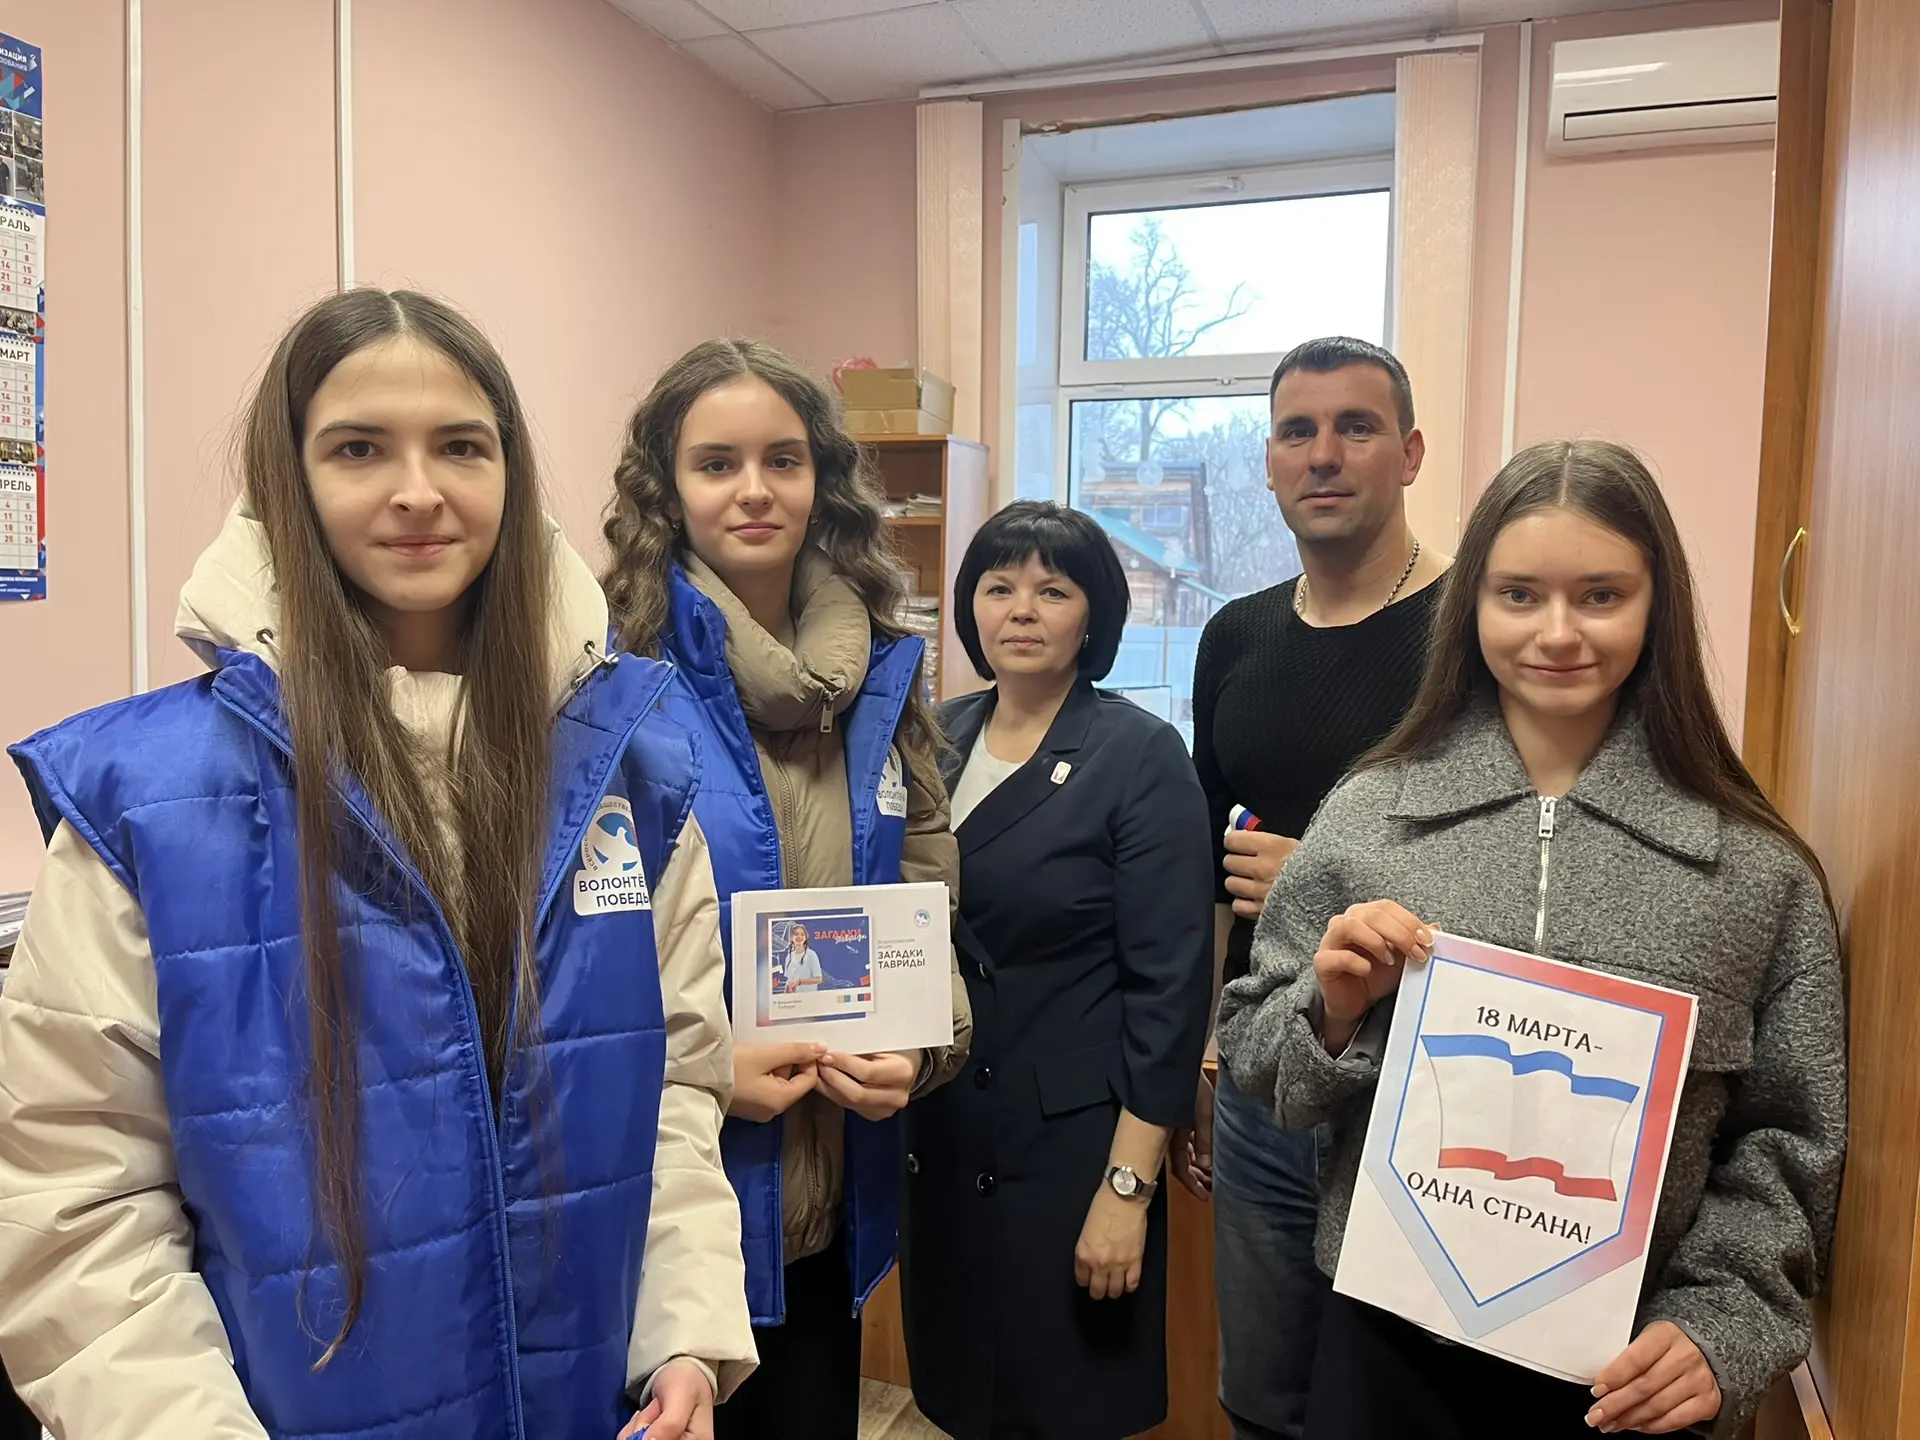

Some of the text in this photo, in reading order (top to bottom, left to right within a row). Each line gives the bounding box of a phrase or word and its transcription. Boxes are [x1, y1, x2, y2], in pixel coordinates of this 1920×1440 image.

[0, 216, 30, 232] РАЛЬ
[2, 249, 8, 257] 7
[1, 261, 32, 274] 14 15
[1, 272, 32, 285] 21 22
[1, 283, 11, 292] 28
[0, 347, 30, 362] МАРТ
[3, 381, 8, 389] 7
[1, 392, 31, 404] 14 15
[1, 404, 31, 415] 21 22
[1, 415, 31, 426] 28 29
[4, 535, 33, 544] 25 26
[878, 948, 923, 960] ЗАГАДКИ
[878, 958, 926, 969] ТАВРИДЫ
[1477, 1006, 1603, 1053] 18 МАРТА-
[1407, 1171, 1591, 1245] ОДНА СТРАНА!
